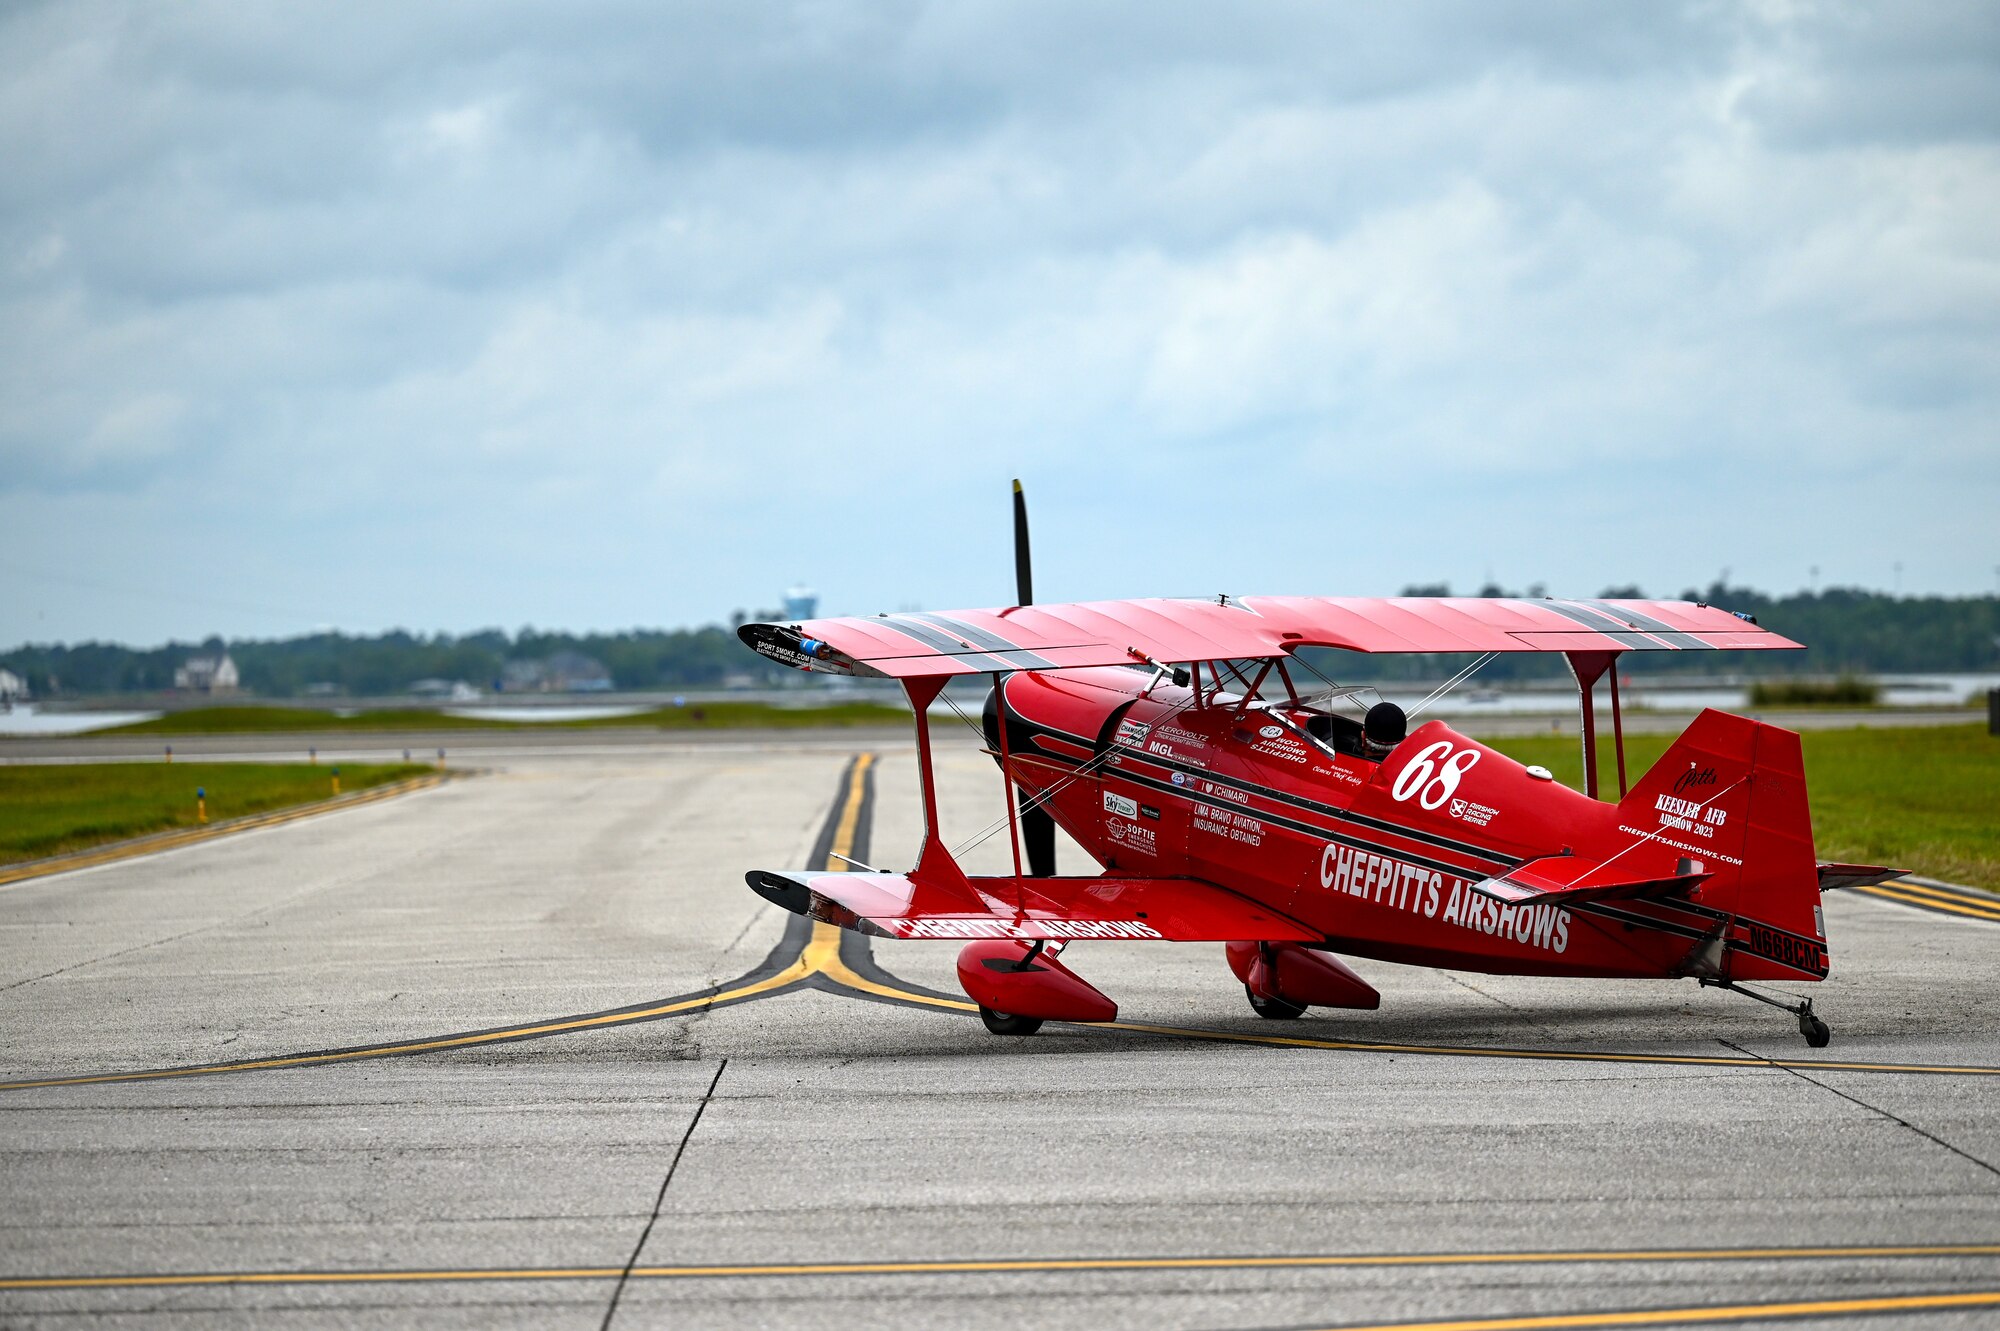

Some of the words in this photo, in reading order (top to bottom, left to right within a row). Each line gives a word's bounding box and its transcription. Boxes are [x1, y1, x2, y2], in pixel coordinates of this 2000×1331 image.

[757, 640, 776, 651] SPORT
[776, 646, 796, 658] SMOKE
[779, 654, 791, 662] SMOKE
[1158, 725, 1209, 742] AEROVOLTZ
[1261, 726, 1281, 736] FCA
[1149, 741, 1173, 757] MGL
[1250, 743, 1307, 764] CHEFPITTS
[1260, 740, 1307, 756] AIRSHOWS
[1391, 740, 1482, 811] 68
[1673, 767, 1717, 794] Pitts
[1201, 781, 1205, 791] I
[1214, 785, 1249, 804] ICHIMARU
[1105, 796, 1118, 813] Sky
[1194, 803, 1209, 818] LIMA
[1211, 808, 1231, 825] BRAVO
[1469, 802, 1500, 816] AIRSHOW
[1654, 793, 1701, 819] KEESLER
[1703, 806, 1727, 826] AFB
[1462, 814, 1488, 827] SERIES
[1466, 808, 1492, 821] RACING
[1127, 823, 1155, 841] SOFTIE
[1193, 817, 1228, 838] INSURANCE
[1230, 828, 1261, 847] OBTAINED
[1658, 812, 1694, 833] AIRSHOW
[1693, 823, 1713, 838] 2023
[1618, 824, 1743, 866] CHEFPITTSAIRSHOWS.COM
[1320, 843, 1443, 919] CHEFPITTS
[1442, 878, 1571, 954] AIRSHOWS
[891, 919, 1030, 938] CHEFPITTS
[1032, 919, 1163, 938] AIRSHOWS
[1749, 924, 1822, 972] N668CM
